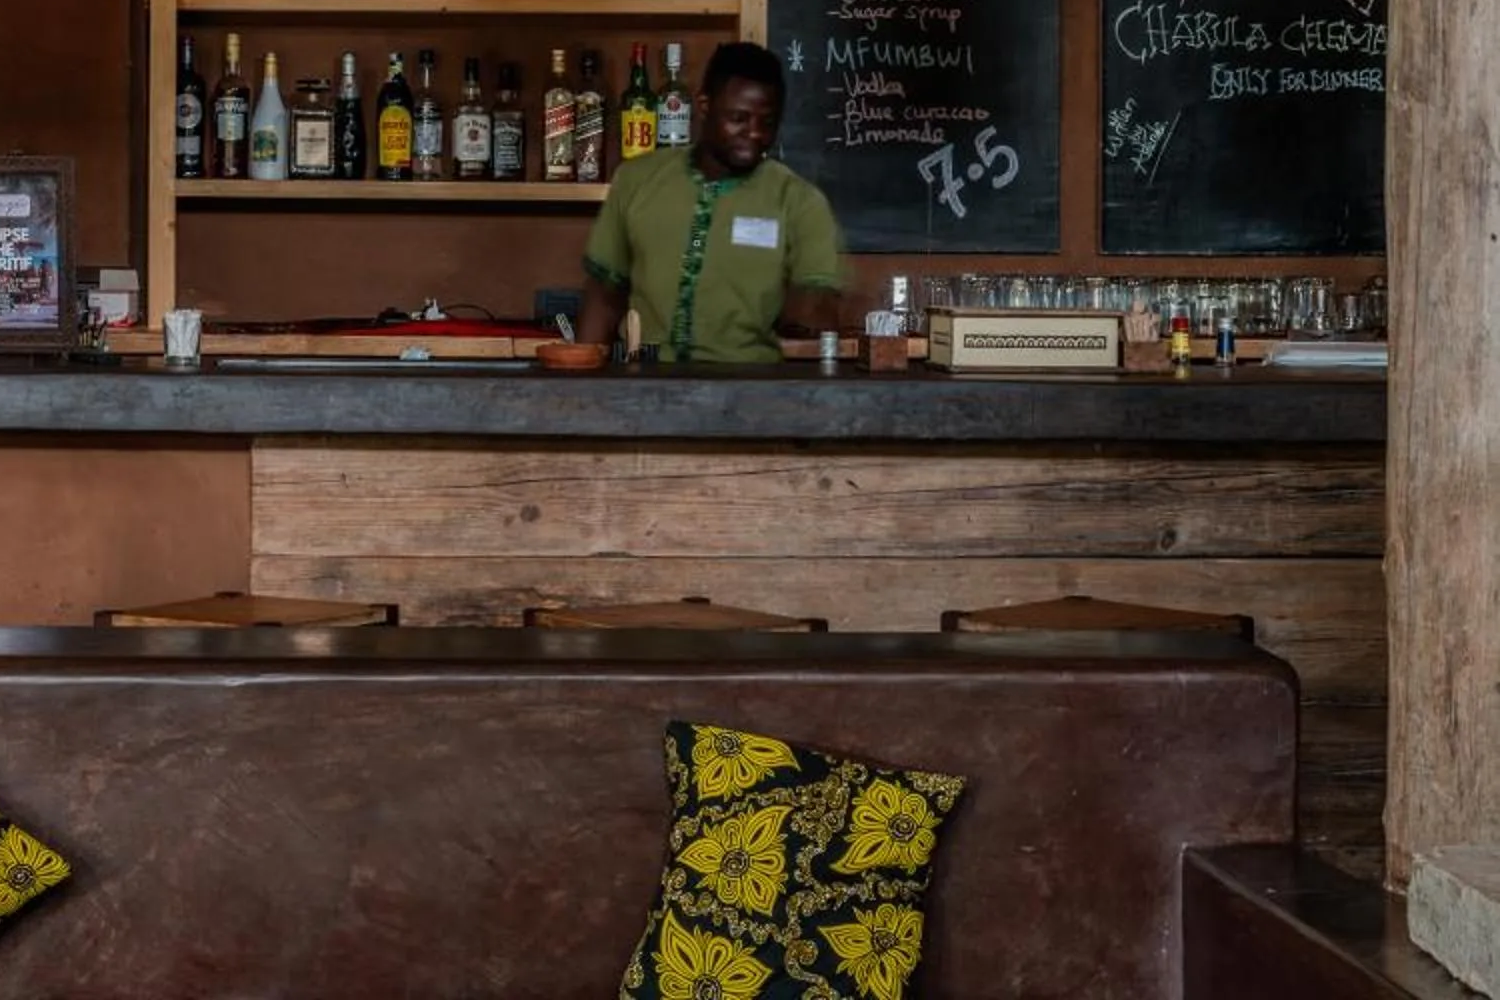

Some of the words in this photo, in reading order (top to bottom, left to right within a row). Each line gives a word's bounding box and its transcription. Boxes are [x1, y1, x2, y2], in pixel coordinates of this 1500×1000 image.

[839, 4, 897, 31] Sugar
[905, 6, 962, 33] syrup
[1114, 0, 1273, 65] CHAKULA
[825, 37, 976, 76] MFUMBWI
[843, 71, 906, 98] Vodka
[1278, 67, 1309, 94] FOR
[1310, 67, 1386, 92] DINNER
[845, 98, 895, 125] Blue
[845, 120, 945, 147] Limonade
[917, 125, 1020, 218] 7.5
